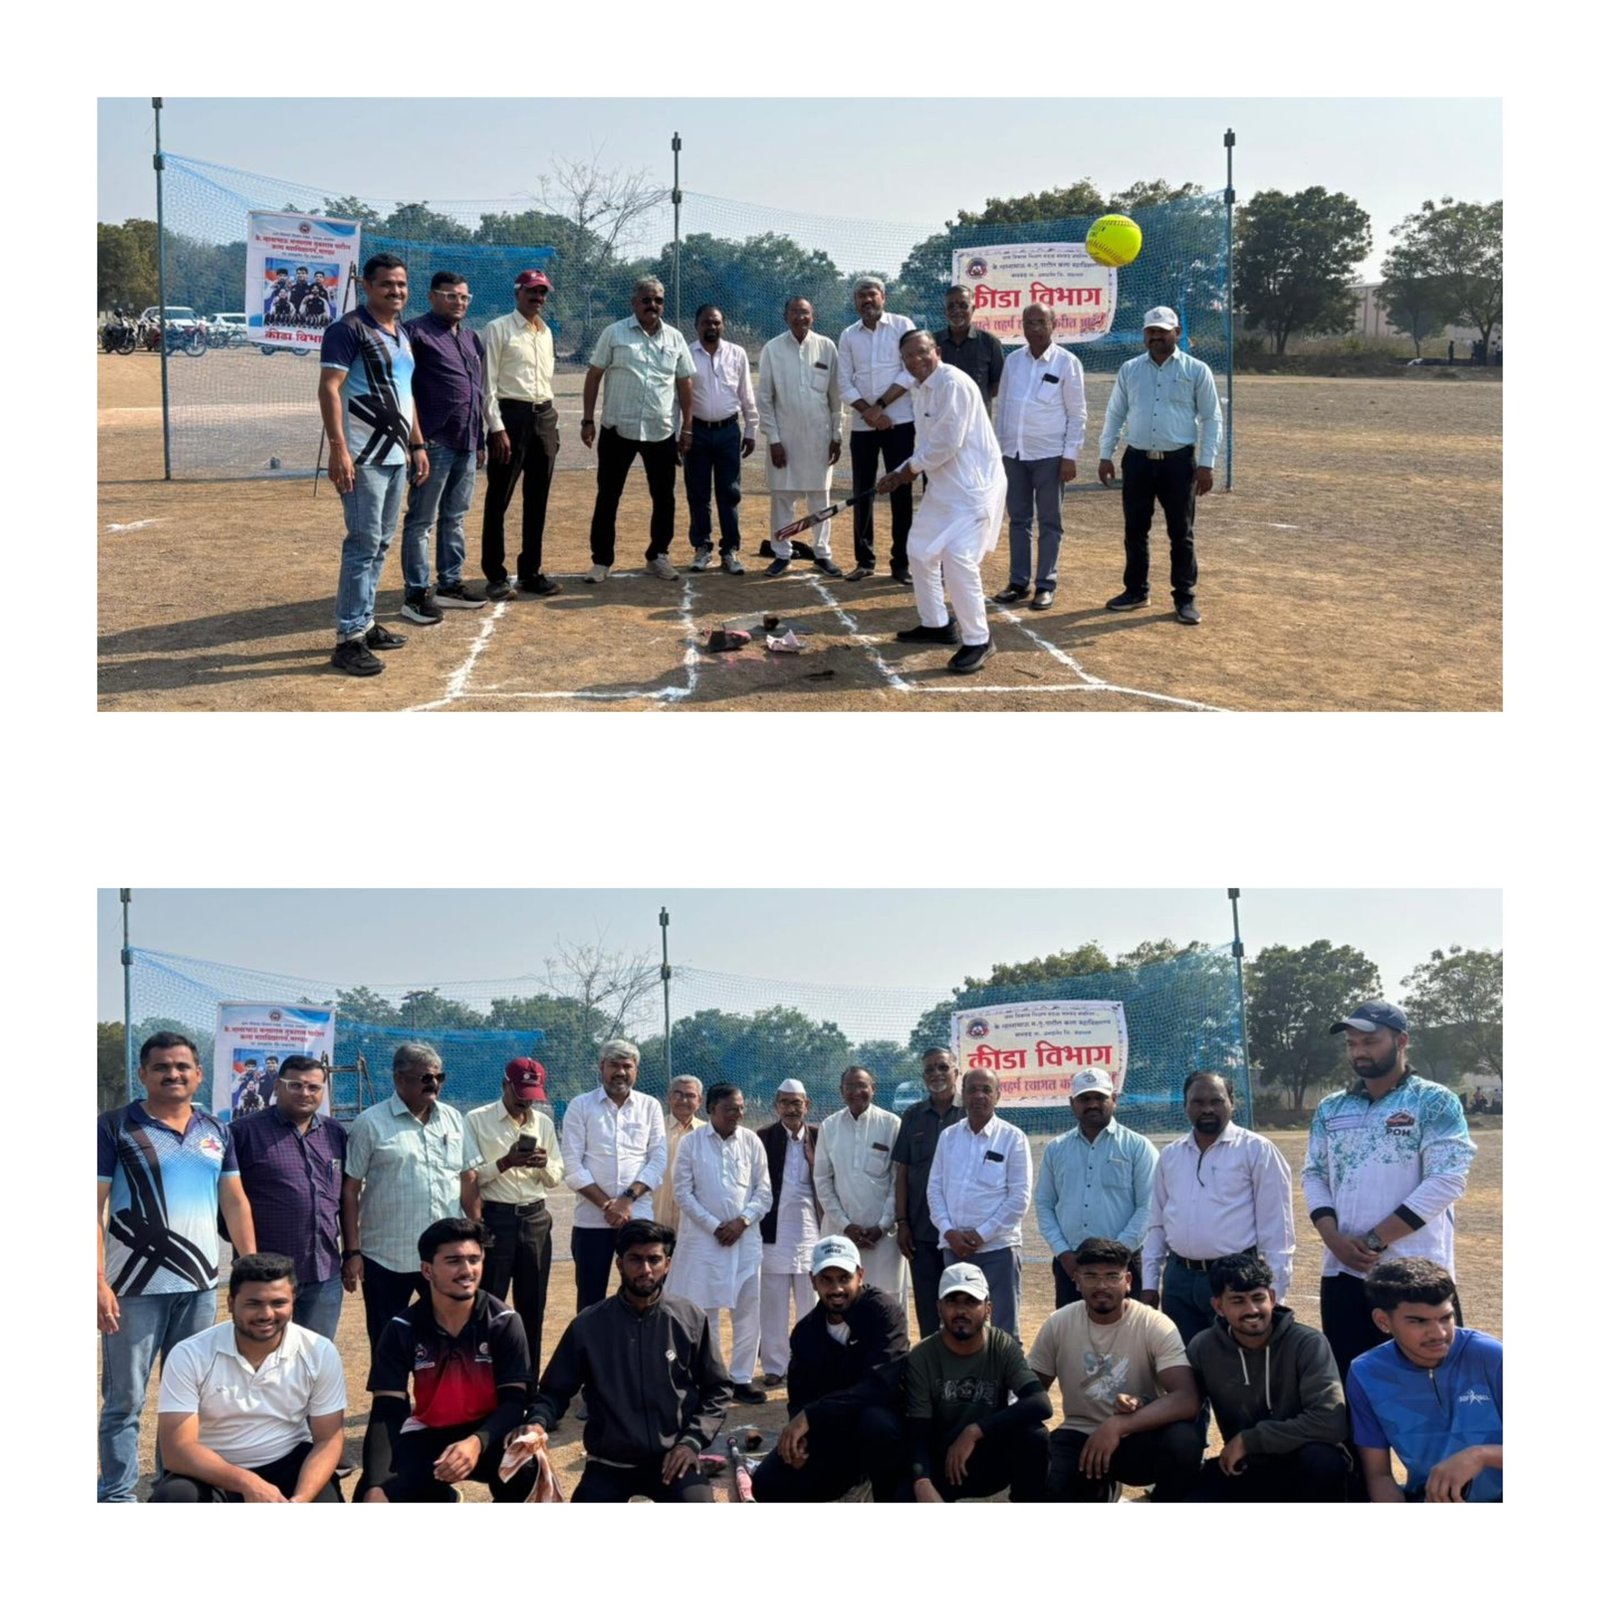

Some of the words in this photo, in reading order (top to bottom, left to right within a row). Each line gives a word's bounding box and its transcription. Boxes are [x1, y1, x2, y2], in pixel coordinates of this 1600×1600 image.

[1029, 281, 1103, 307] विभाग
[296, 330, 325, 343] विभा
[1035, 1040, 1113, 1067] विभाग
